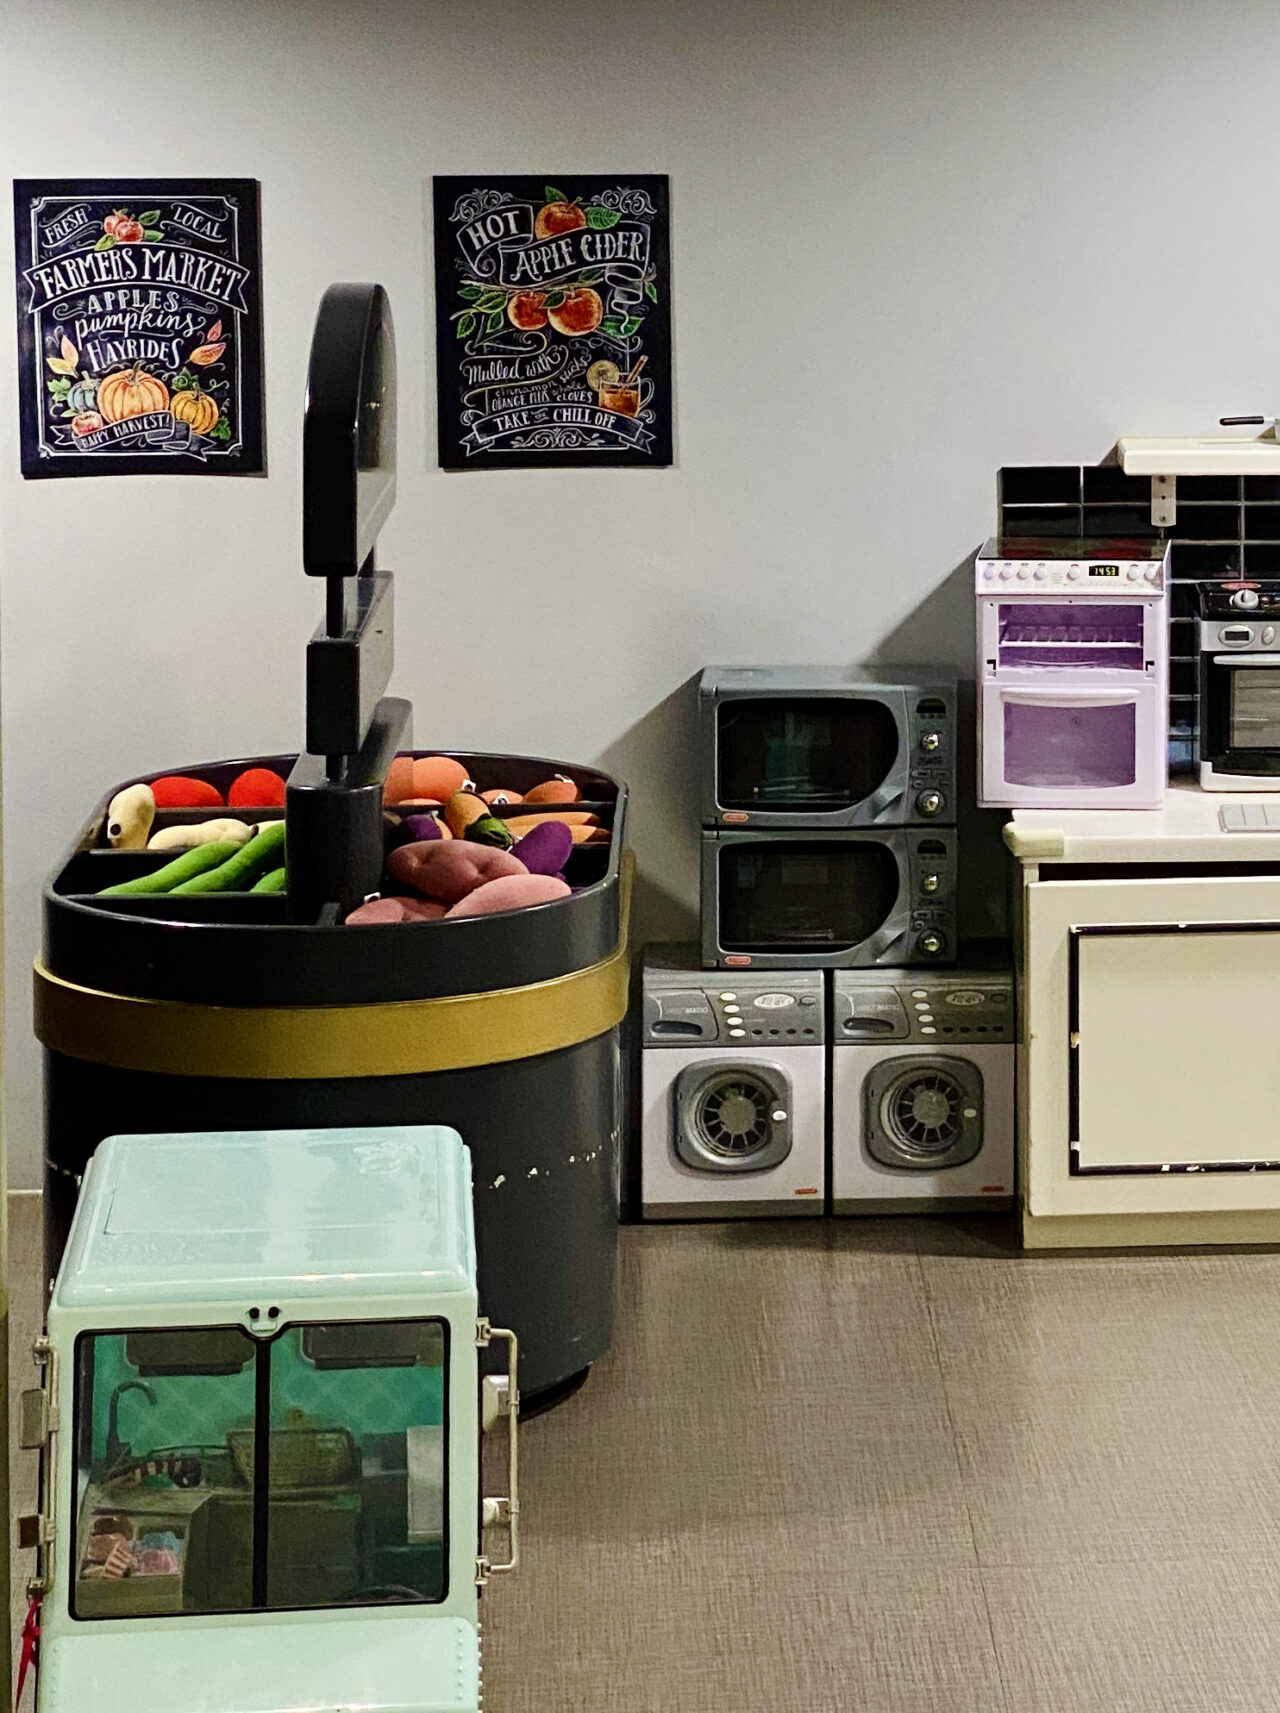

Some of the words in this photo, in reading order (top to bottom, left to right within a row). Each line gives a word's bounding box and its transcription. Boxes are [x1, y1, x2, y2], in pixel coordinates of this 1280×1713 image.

[44, 208, 89, 243] FRESH
[173, 206, 223, 239] LOCAL
[466, 209, 522, 250] HOT
[33, 247, 136, 299] FARMERS
[141, 247, 243, 302] MARKET
[510, 239, 576, 282] APPLE
[580, 231, 646, 263] CIDER
[87, 288, 180, 315] APPLES
[85, 337, 185, 373] HAYRIDES
[462, 357, 525, 386] Mulled
[525, 346, 561, 377] with
[492, 410, 531, 432] TAKE
[553, 408, 592, 423] CHILL
[594, 411, 617, 431] OFF
